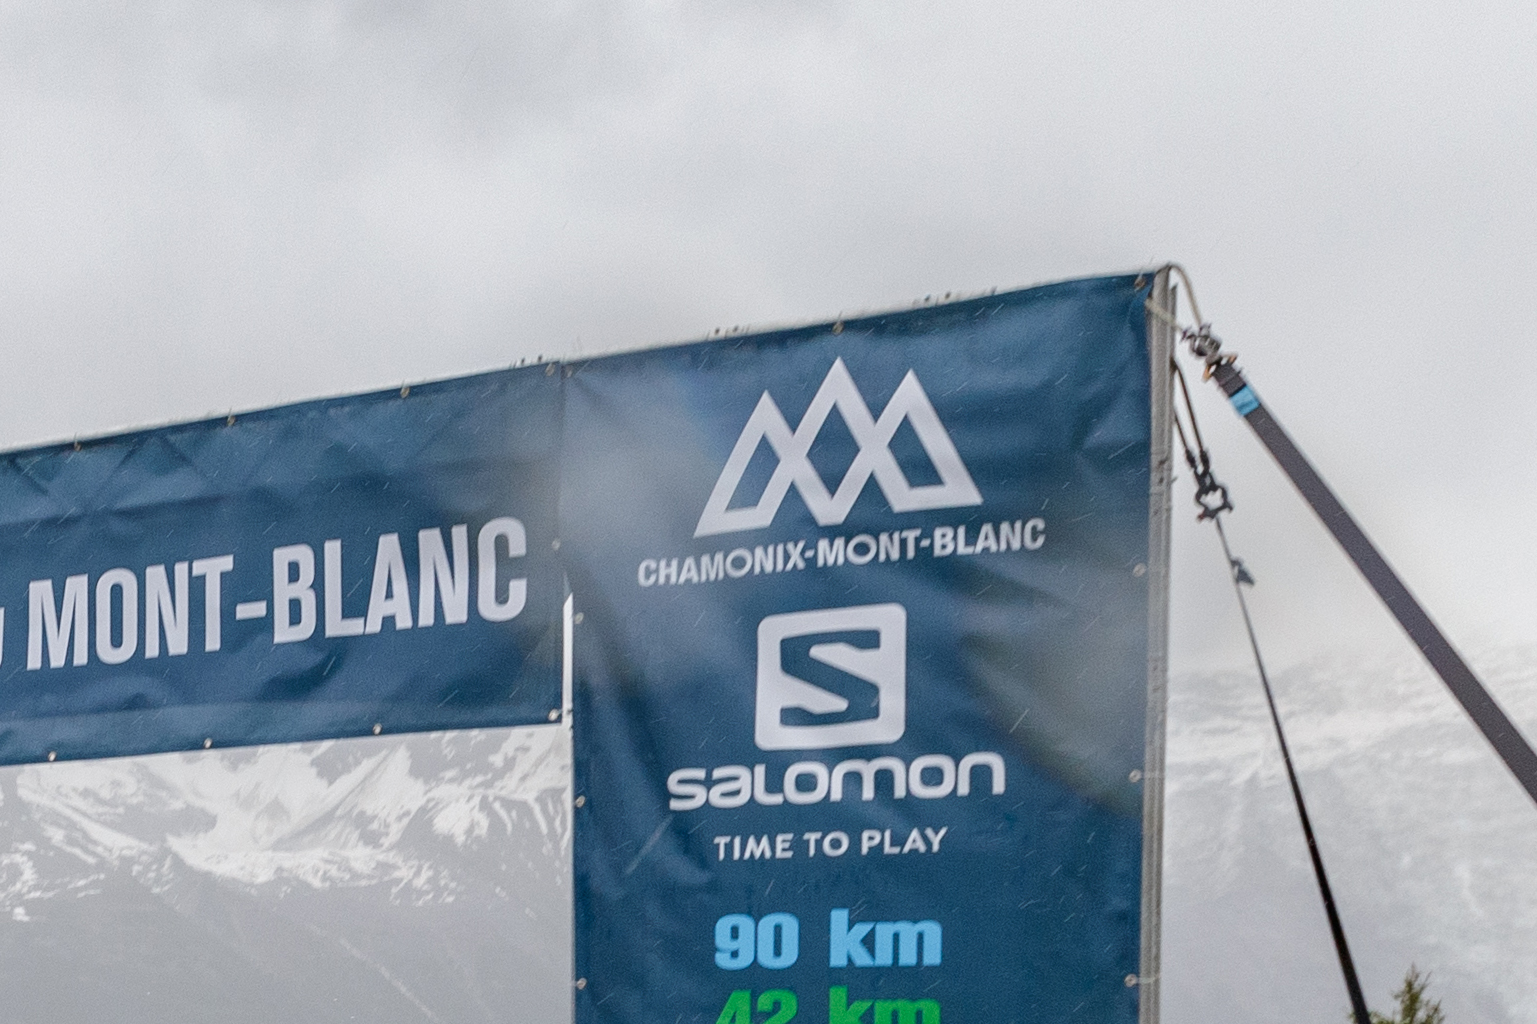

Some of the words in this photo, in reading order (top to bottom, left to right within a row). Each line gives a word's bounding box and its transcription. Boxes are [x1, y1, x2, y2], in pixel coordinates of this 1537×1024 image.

[638, 519, 1045, 587] CHAMONIX-MONT-BLANC
[27, 516, 527, 671] MONT-BLANC
[667, 752, 1005, 811] salomon
[714, 833, 794, 861] TIME
[803, 831, 849, 857] TO
[861, 827, 947, 855] PLAY
[715, 913, 799, 970] 90
[829, 908, 942, 967] km
